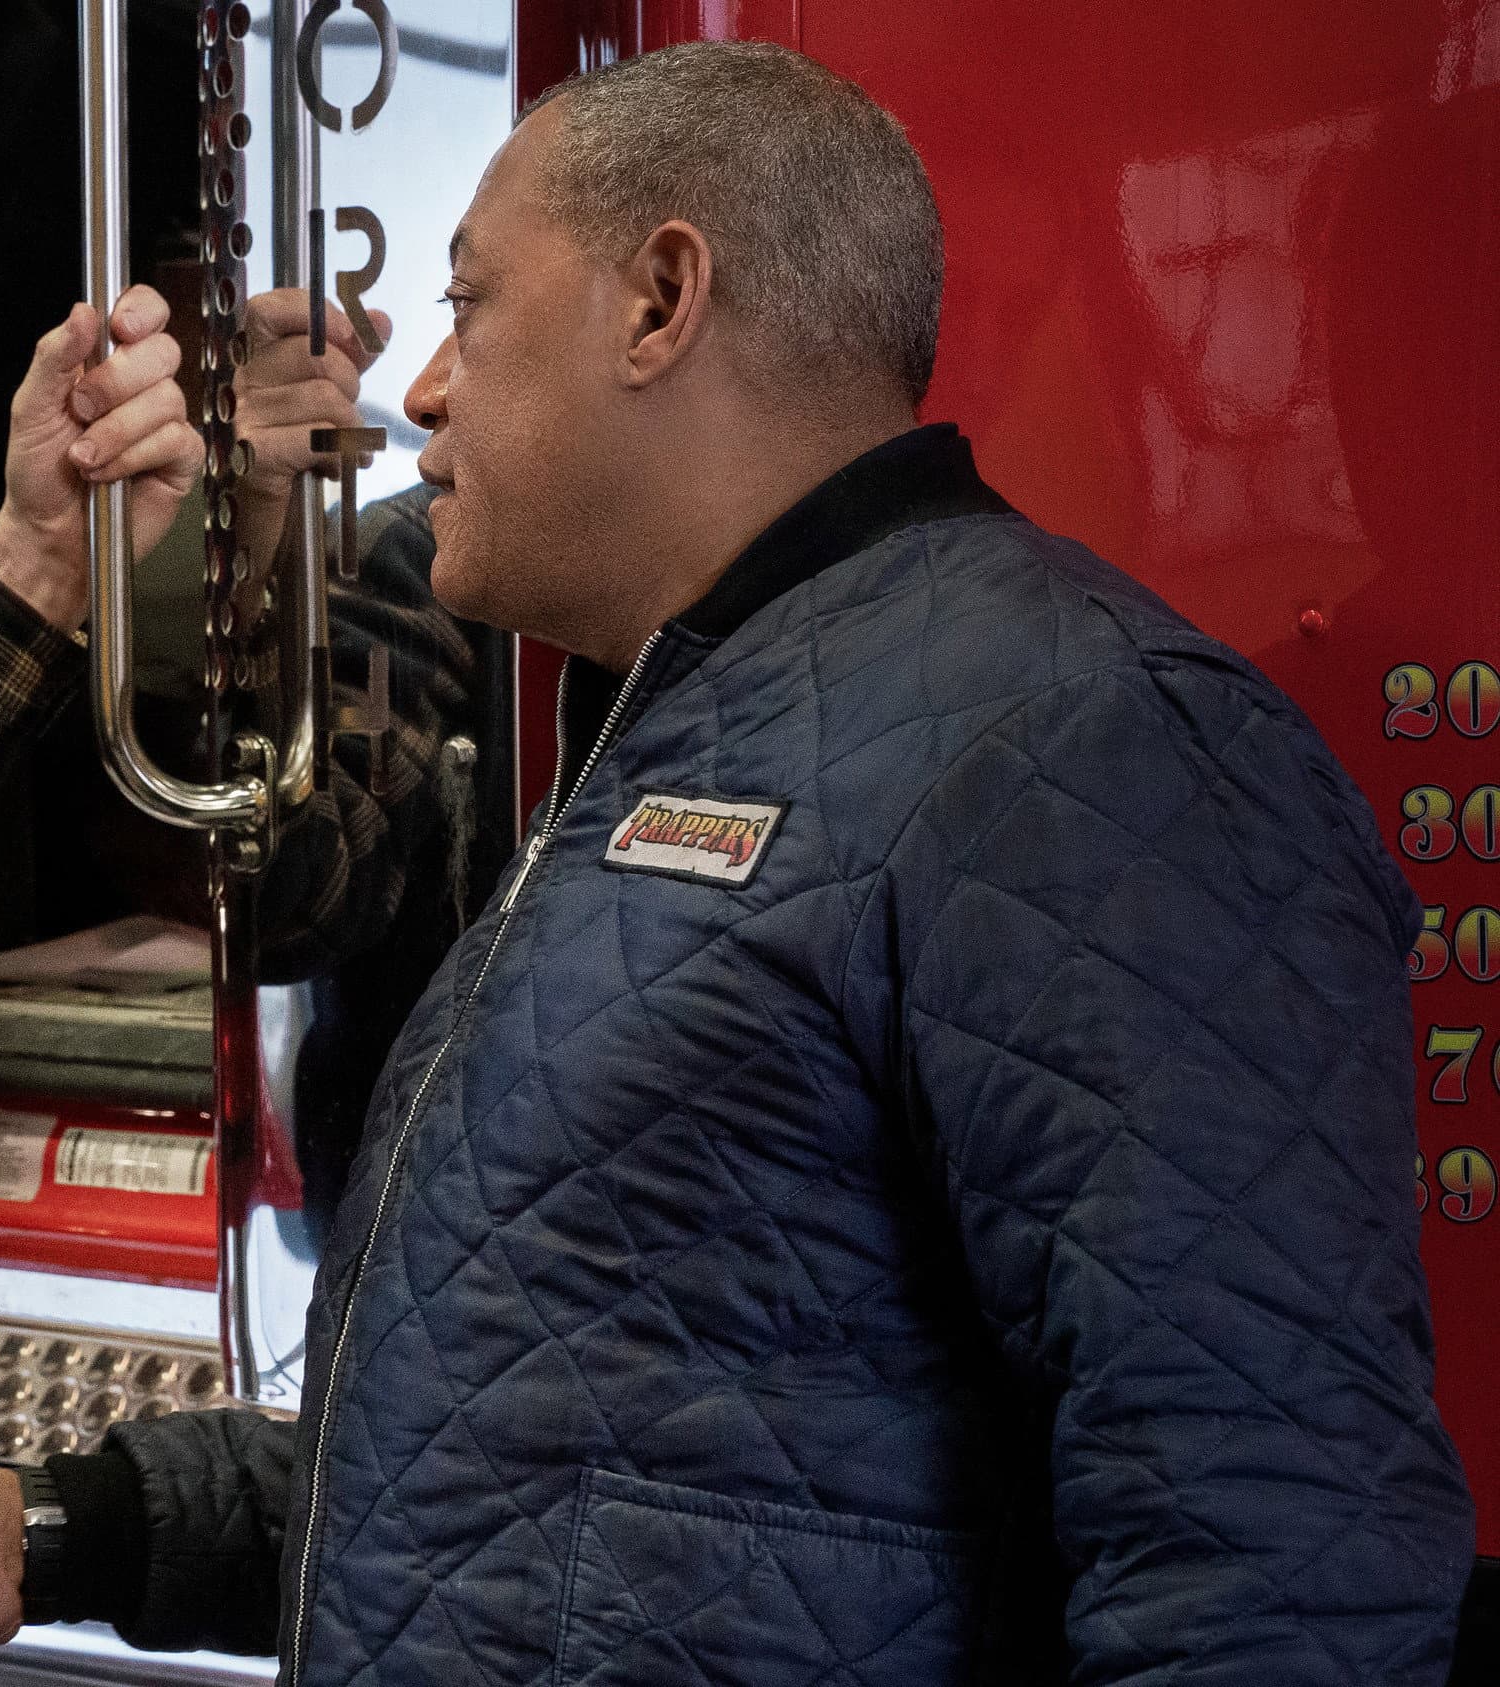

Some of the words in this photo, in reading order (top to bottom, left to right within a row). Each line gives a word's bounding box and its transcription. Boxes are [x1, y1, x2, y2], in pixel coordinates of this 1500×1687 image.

[1382, 660, 1500, 740] 20
[614, 803, 769, 868] TRAPPERS
[1399, 783, 1500, 864] 30
[1408, 904, 1500, 981] 50
[1425, 1024, 1500, 1103] 7
